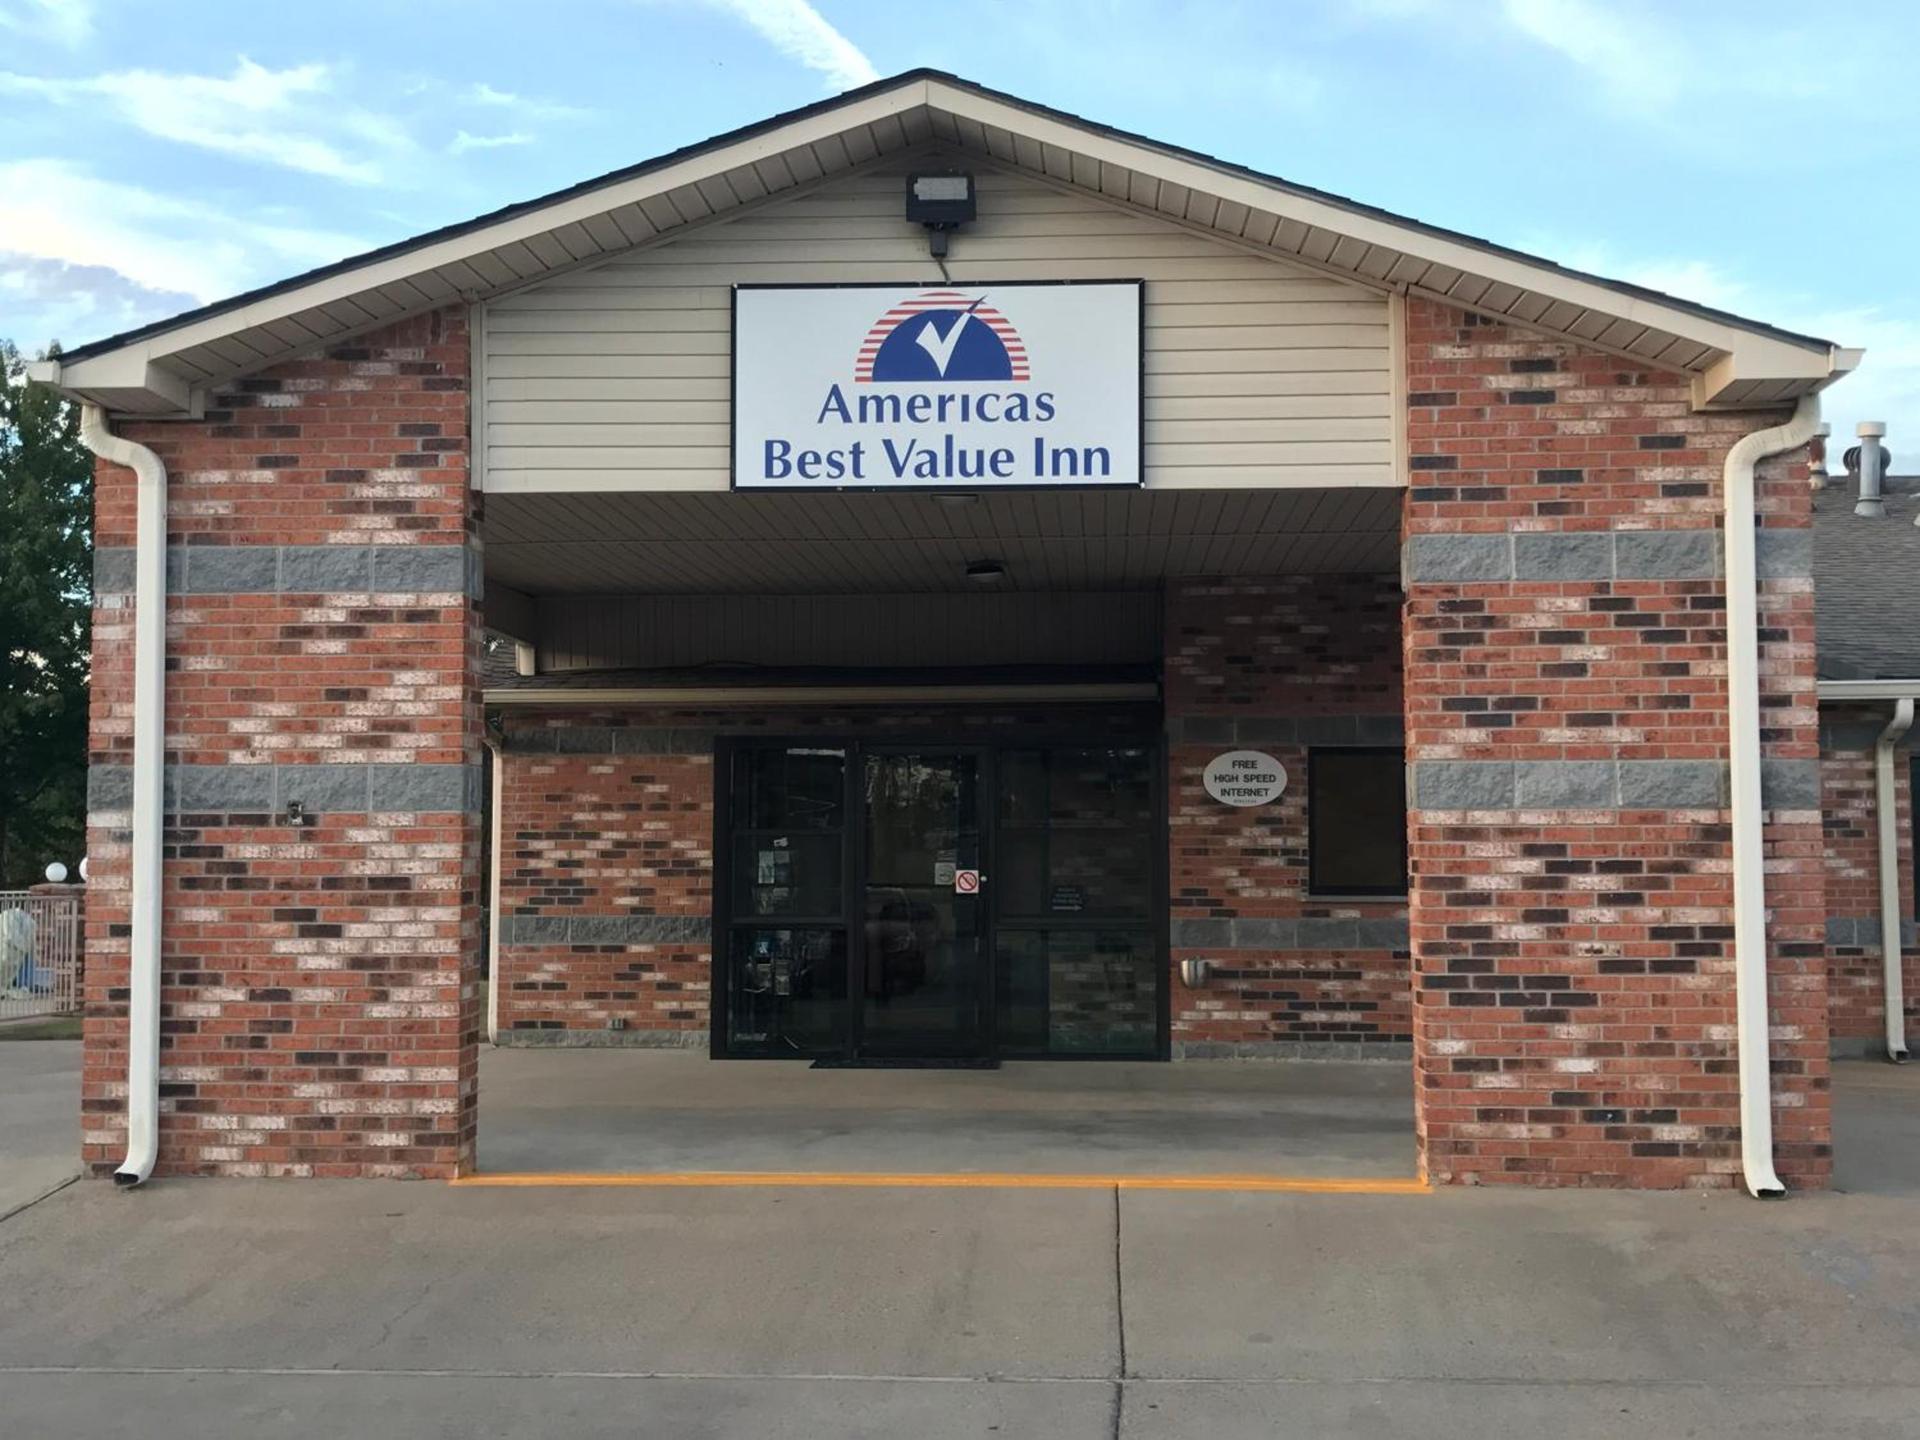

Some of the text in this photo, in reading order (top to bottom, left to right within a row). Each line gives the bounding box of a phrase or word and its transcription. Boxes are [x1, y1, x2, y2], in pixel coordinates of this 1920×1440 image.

[817, 383, 1056, 425] Americas
[763, 434, 1111, 480] Best Value Inn
[1232, 760, 1258, 769] FREE
[1214, 774, 1277, 783] HIGH SPEED
[1221, 788, 1270, 797] INTERNET
